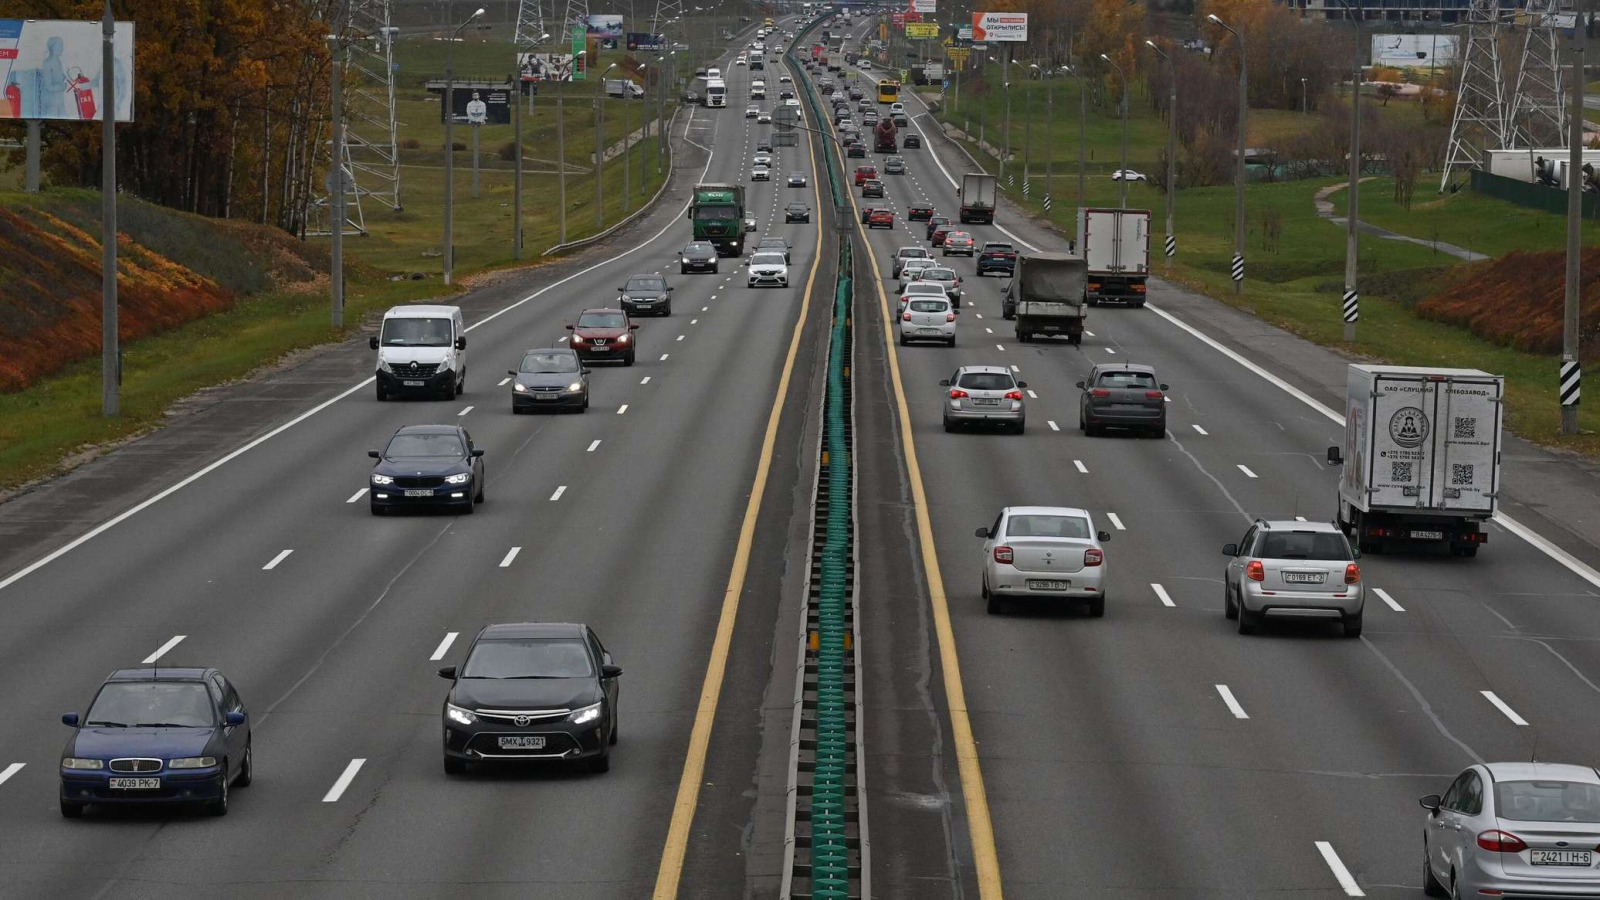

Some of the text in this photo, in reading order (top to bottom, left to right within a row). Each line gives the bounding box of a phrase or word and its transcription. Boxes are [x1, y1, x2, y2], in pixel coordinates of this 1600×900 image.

[501, 737, 518, 746] 5MX
[526, 737, 544, 746] 9321
[117, 778, 159, 788] 4039 PK-7
[1540, 851, 1562, 862] 2421
